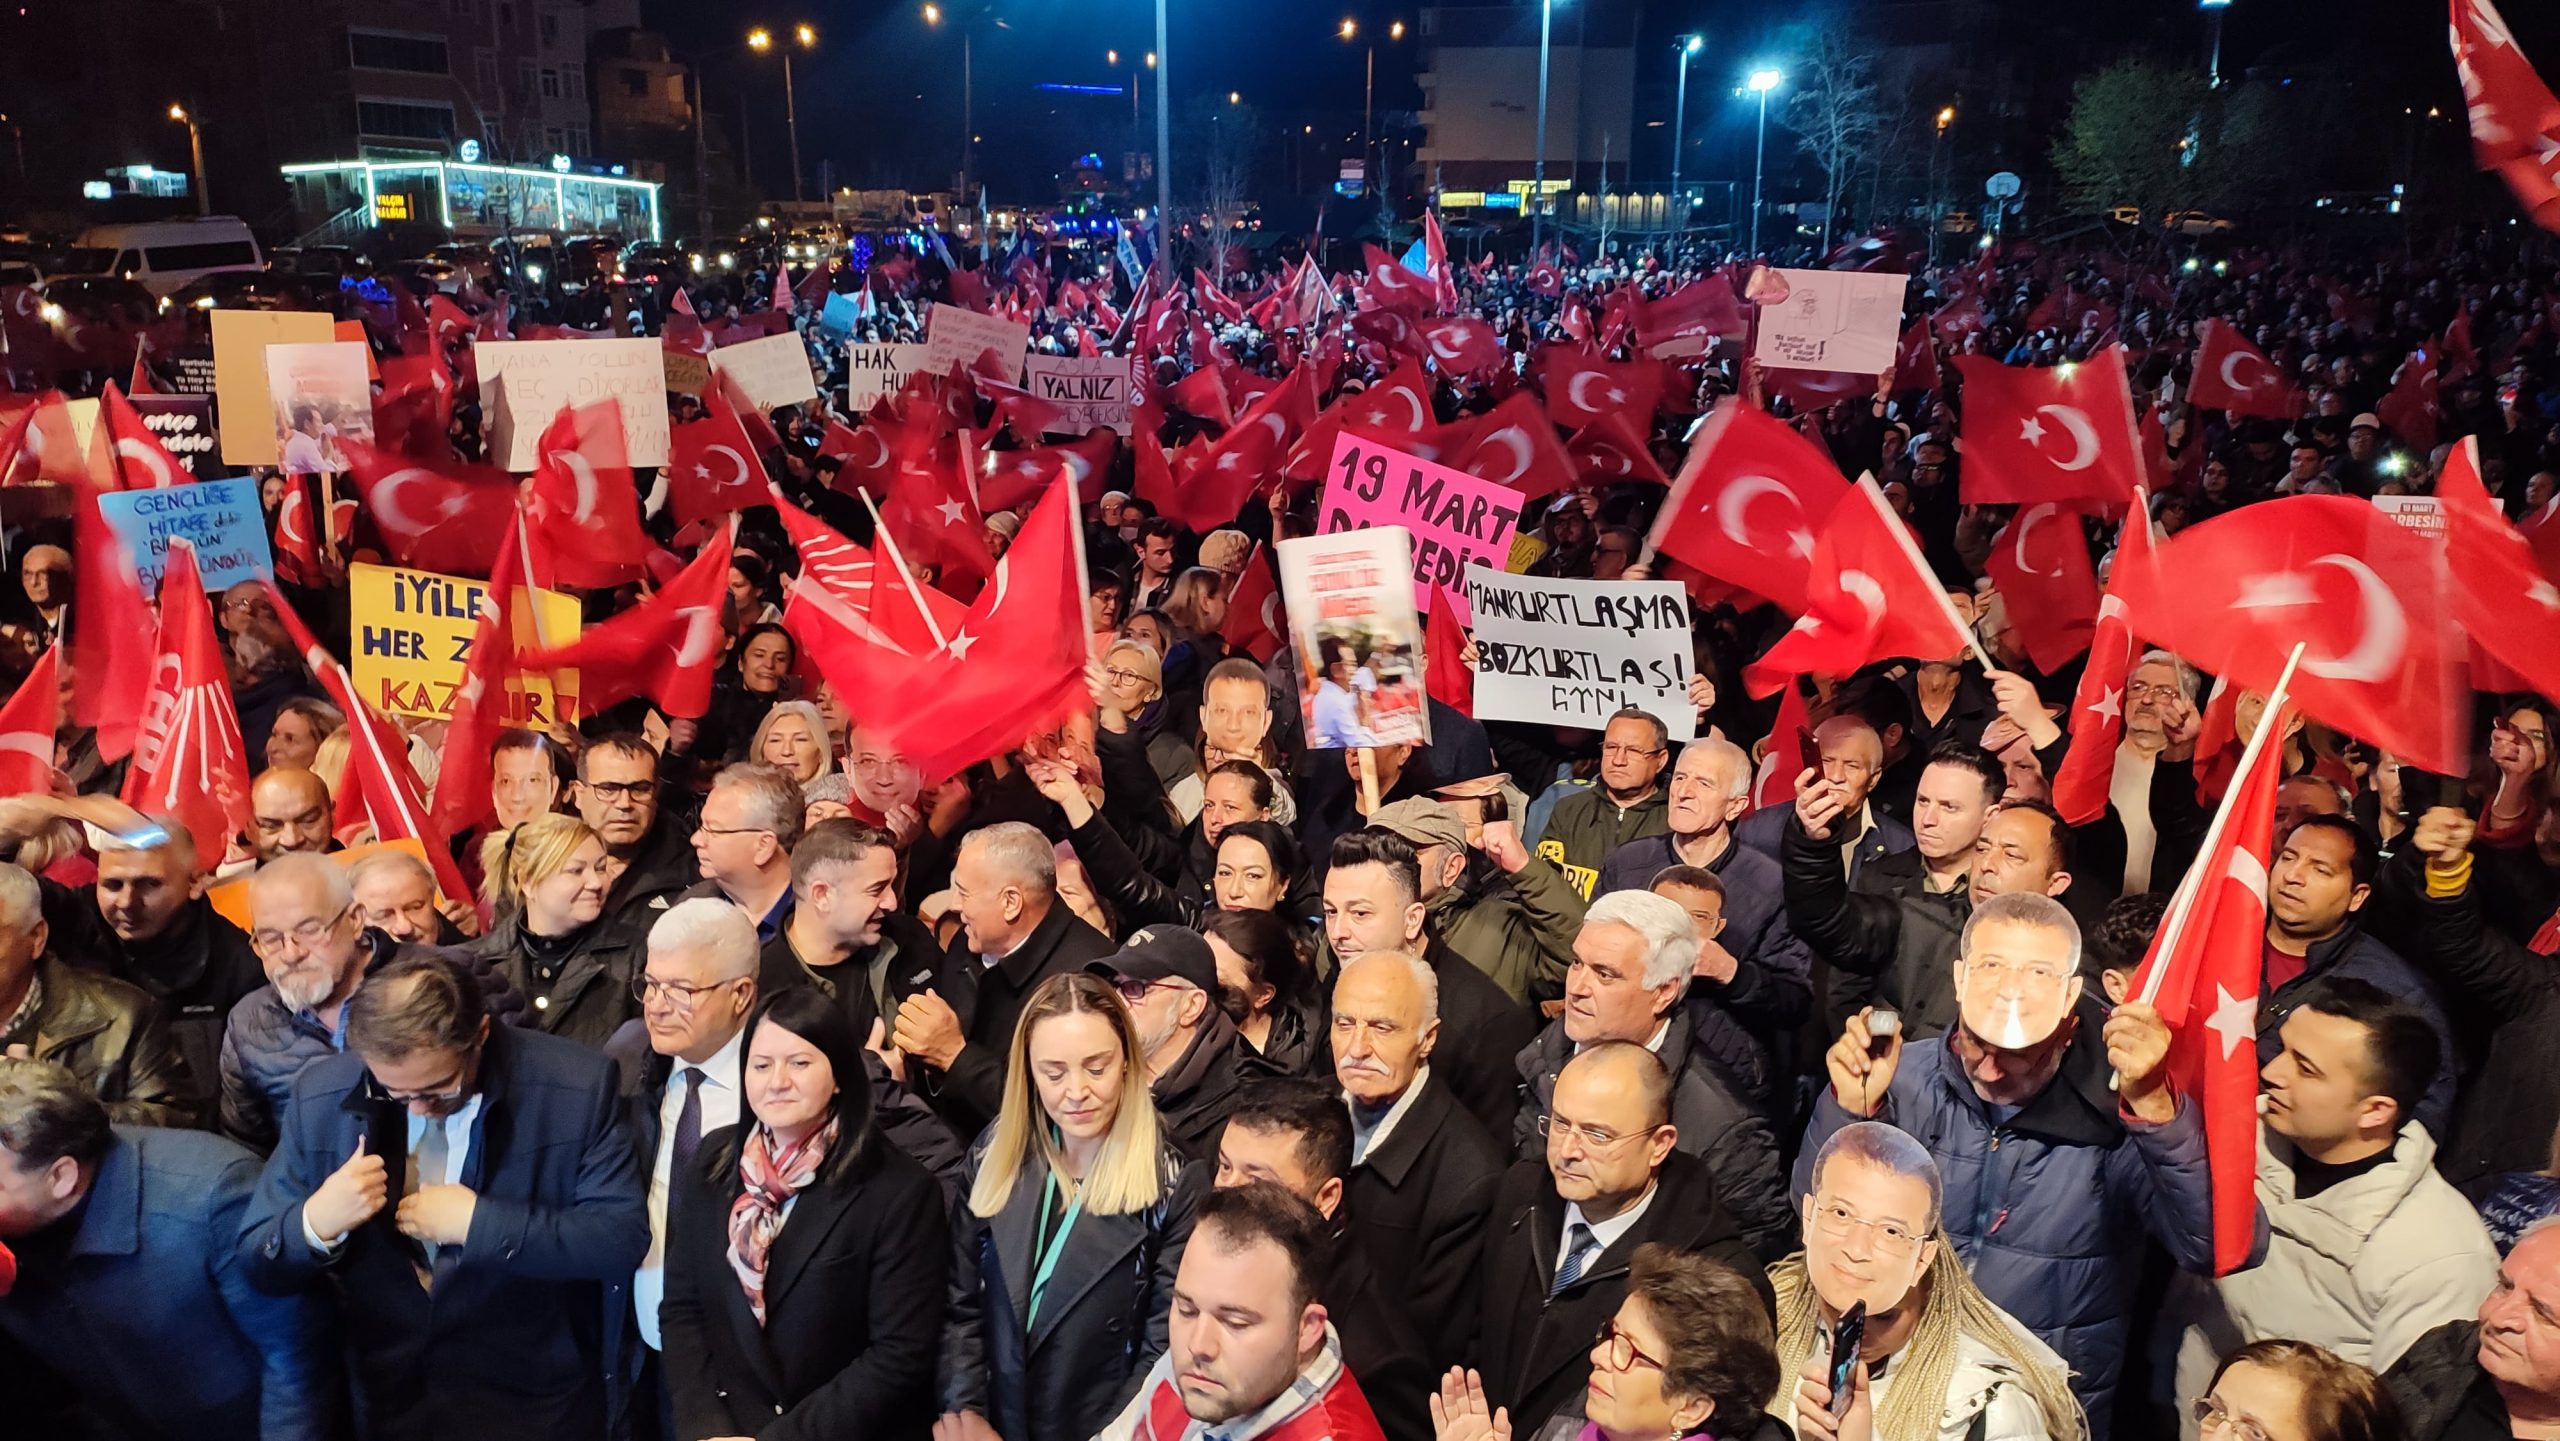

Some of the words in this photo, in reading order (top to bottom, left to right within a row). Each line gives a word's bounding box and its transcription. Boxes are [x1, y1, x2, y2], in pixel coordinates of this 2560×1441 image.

[855, 347, 896, 371] HAK
[1042, 376, 1116, 401] YALNIZ
[1338, 446, 1388, 502] 19
[1400, 468, 1519, 546] MART
[2411, 503, 2434, 514] MART
[1469, 580, 1687, 638] MANKURTLAŞMA
[362, 624, 430, 662] HER
[1475, 640, 1688, 698] BOZKURTLAŞ!
[134, 652, 184, 775] CHP
